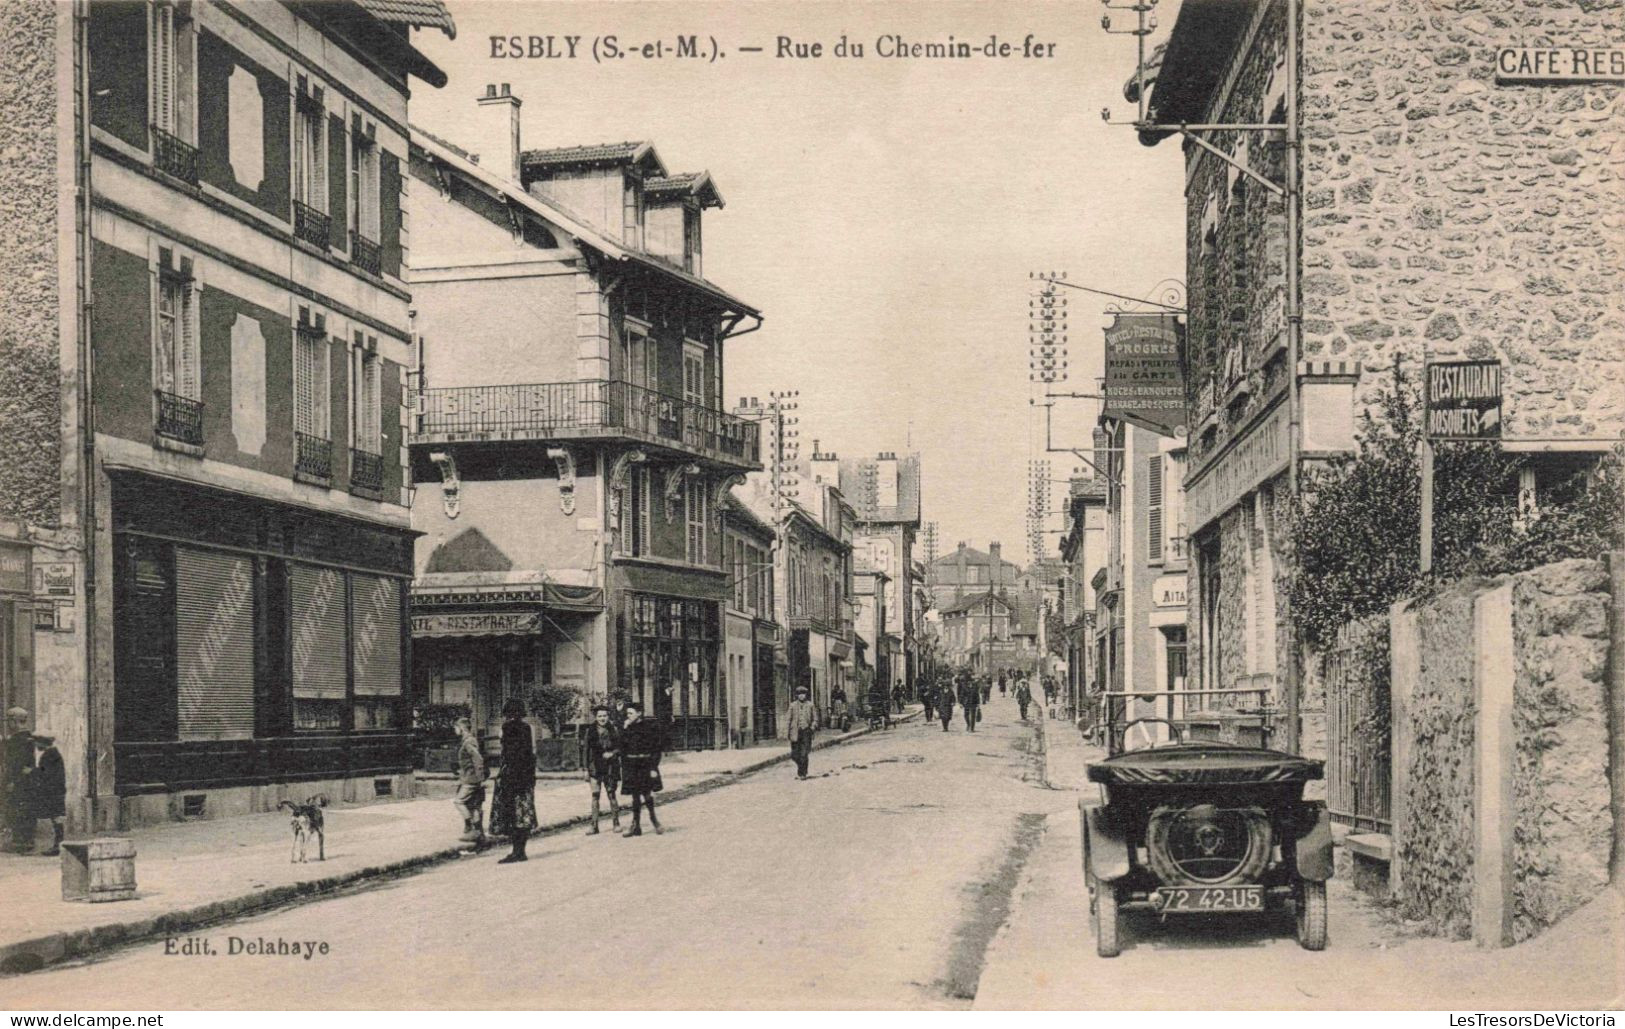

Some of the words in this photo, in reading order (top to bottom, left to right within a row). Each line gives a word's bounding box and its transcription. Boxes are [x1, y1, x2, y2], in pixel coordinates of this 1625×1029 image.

[1499, 48, 1560, 74] CAFE
[1430, 364, 1500, 402] RESTAURANT
[1430, 408, 1479, 436] BOSQUETS
